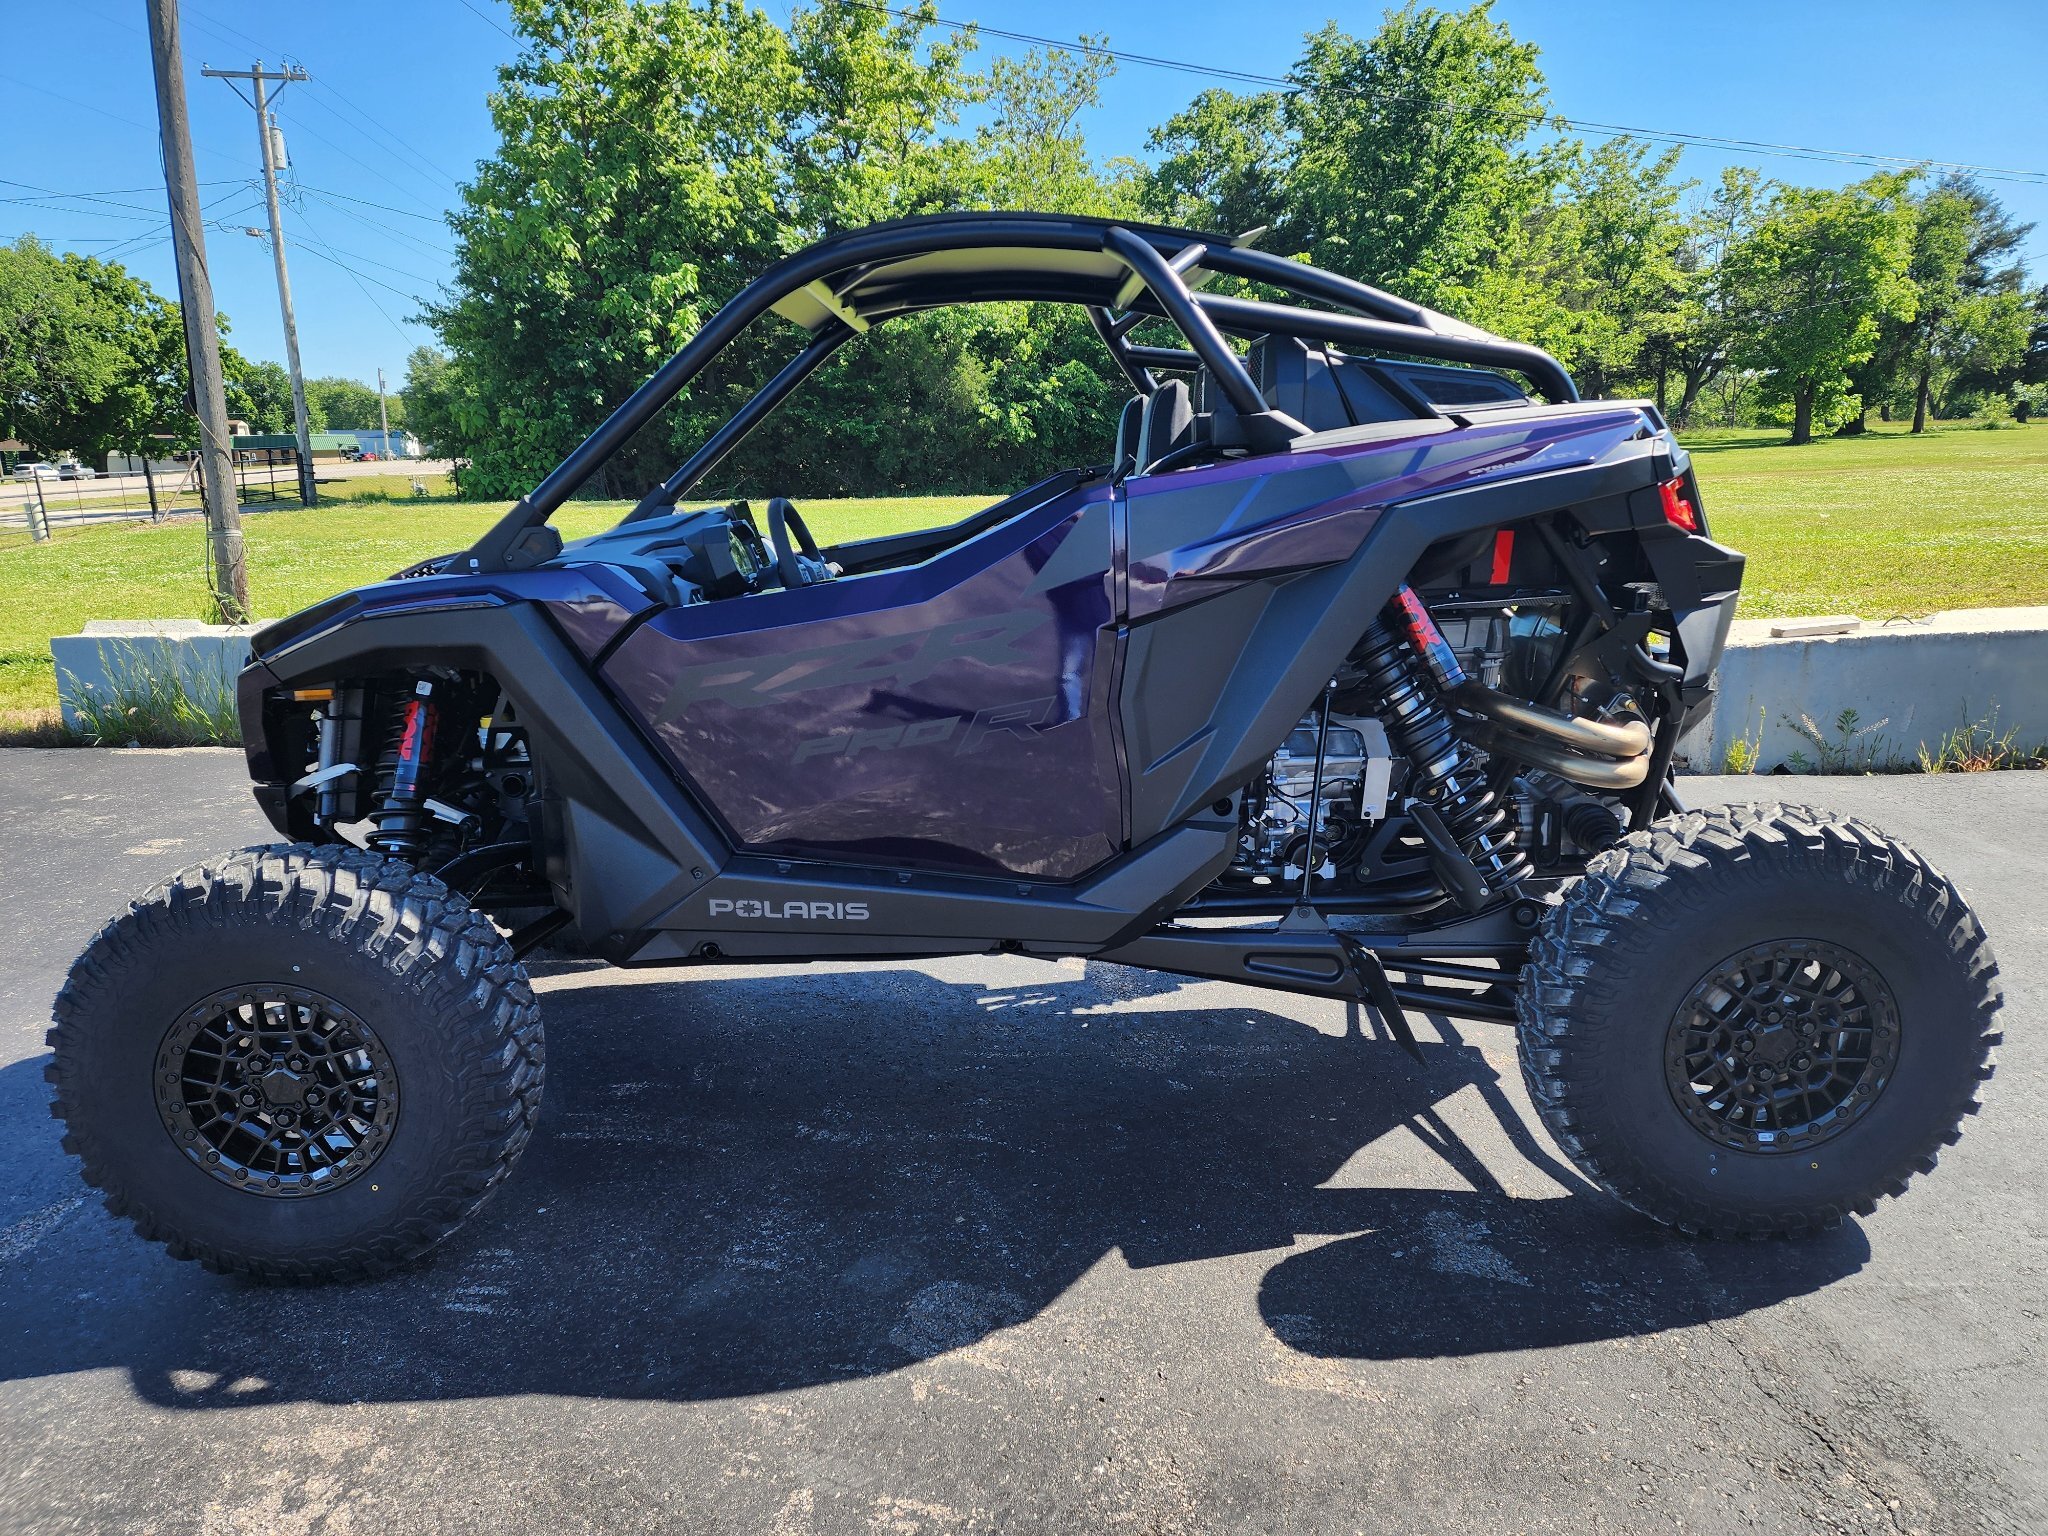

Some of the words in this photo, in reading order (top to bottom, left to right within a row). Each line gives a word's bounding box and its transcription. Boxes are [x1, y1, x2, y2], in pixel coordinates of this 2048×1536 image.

[652, 608, 1055, 726] RZR
[792, 716, 963, 765] PRO
[953, 695, 1057, 758] R
[708, 898, 870, 921] POLARIS
